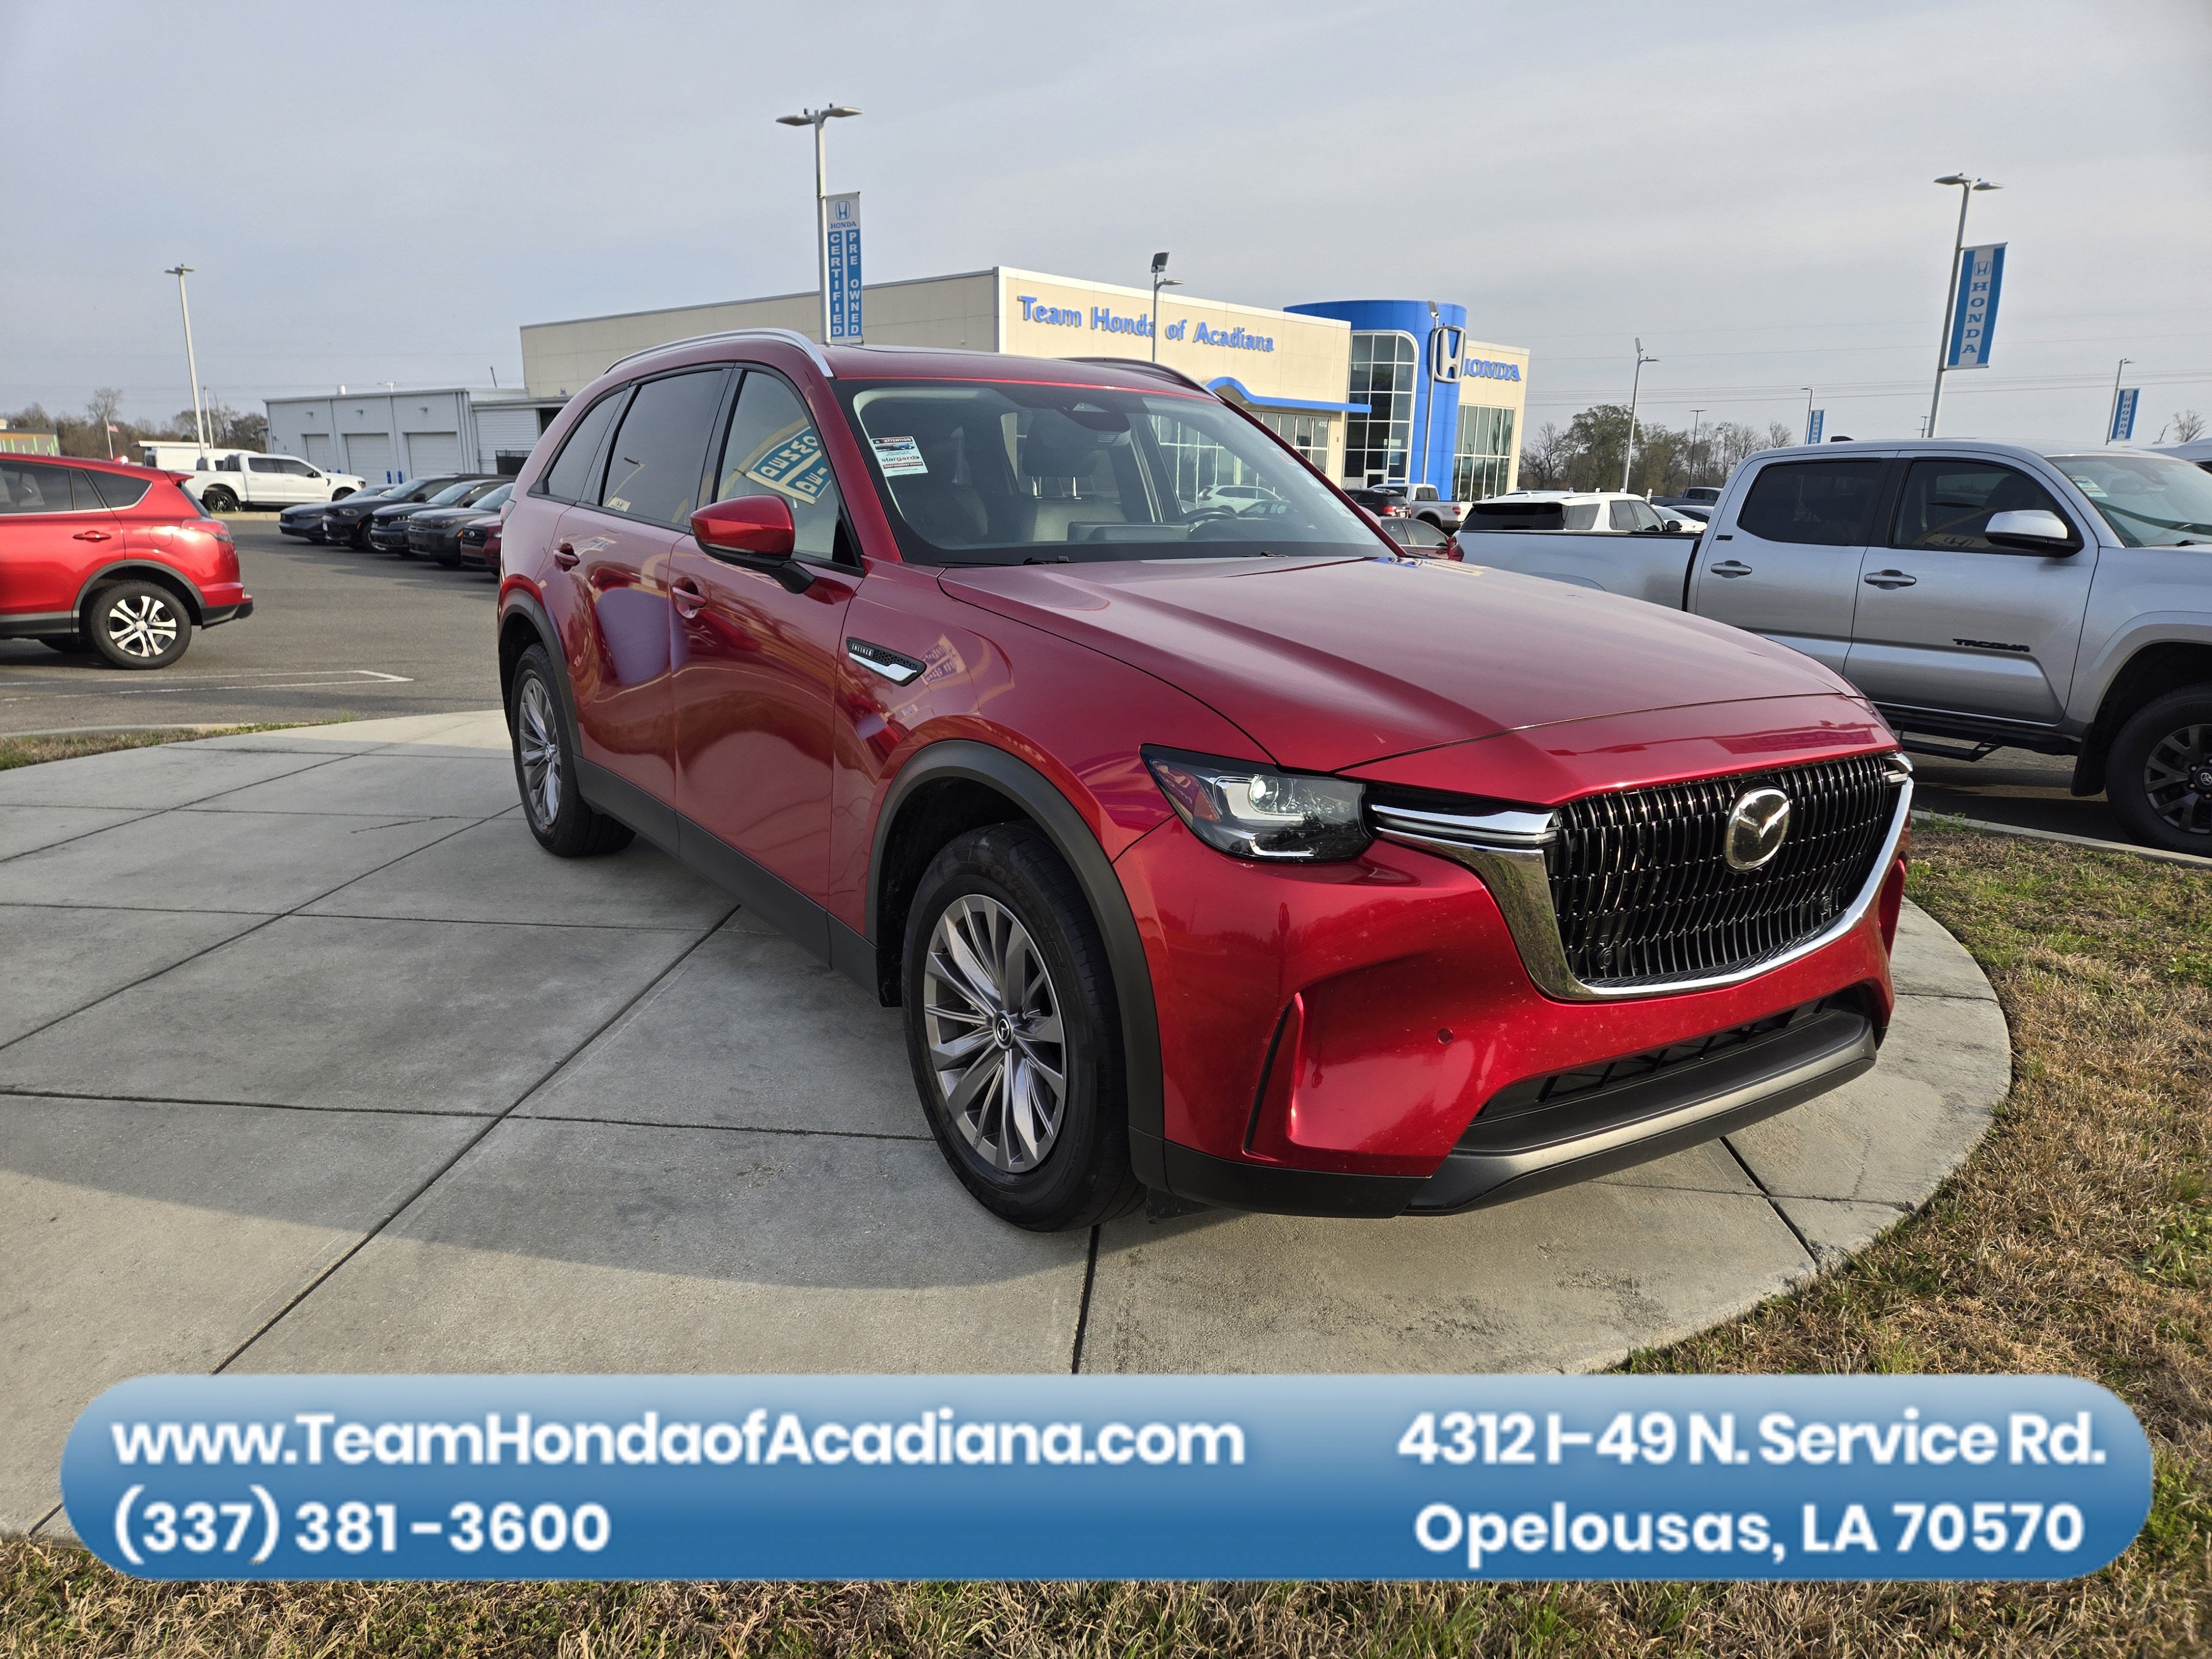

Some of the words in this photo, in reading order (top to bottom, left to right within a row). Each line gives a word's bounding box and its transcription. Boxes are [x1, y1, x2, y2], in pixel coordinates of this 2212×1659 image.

[849, 232, 858, 265] PRE
[830, 234, 842, 335] CERTIFIED
[850, 278, 859, 333] OWNED
[1019, 295, 1082, 327] Team
[1092, 306, 1155, 336] Honda
[1166, 319, 1187, 340] of
[1194, 322, 1274, 352] Acadiana
[1961, 281, 1989, 353] HONDA
[1953, 638, 2030, 652] TACOMA
